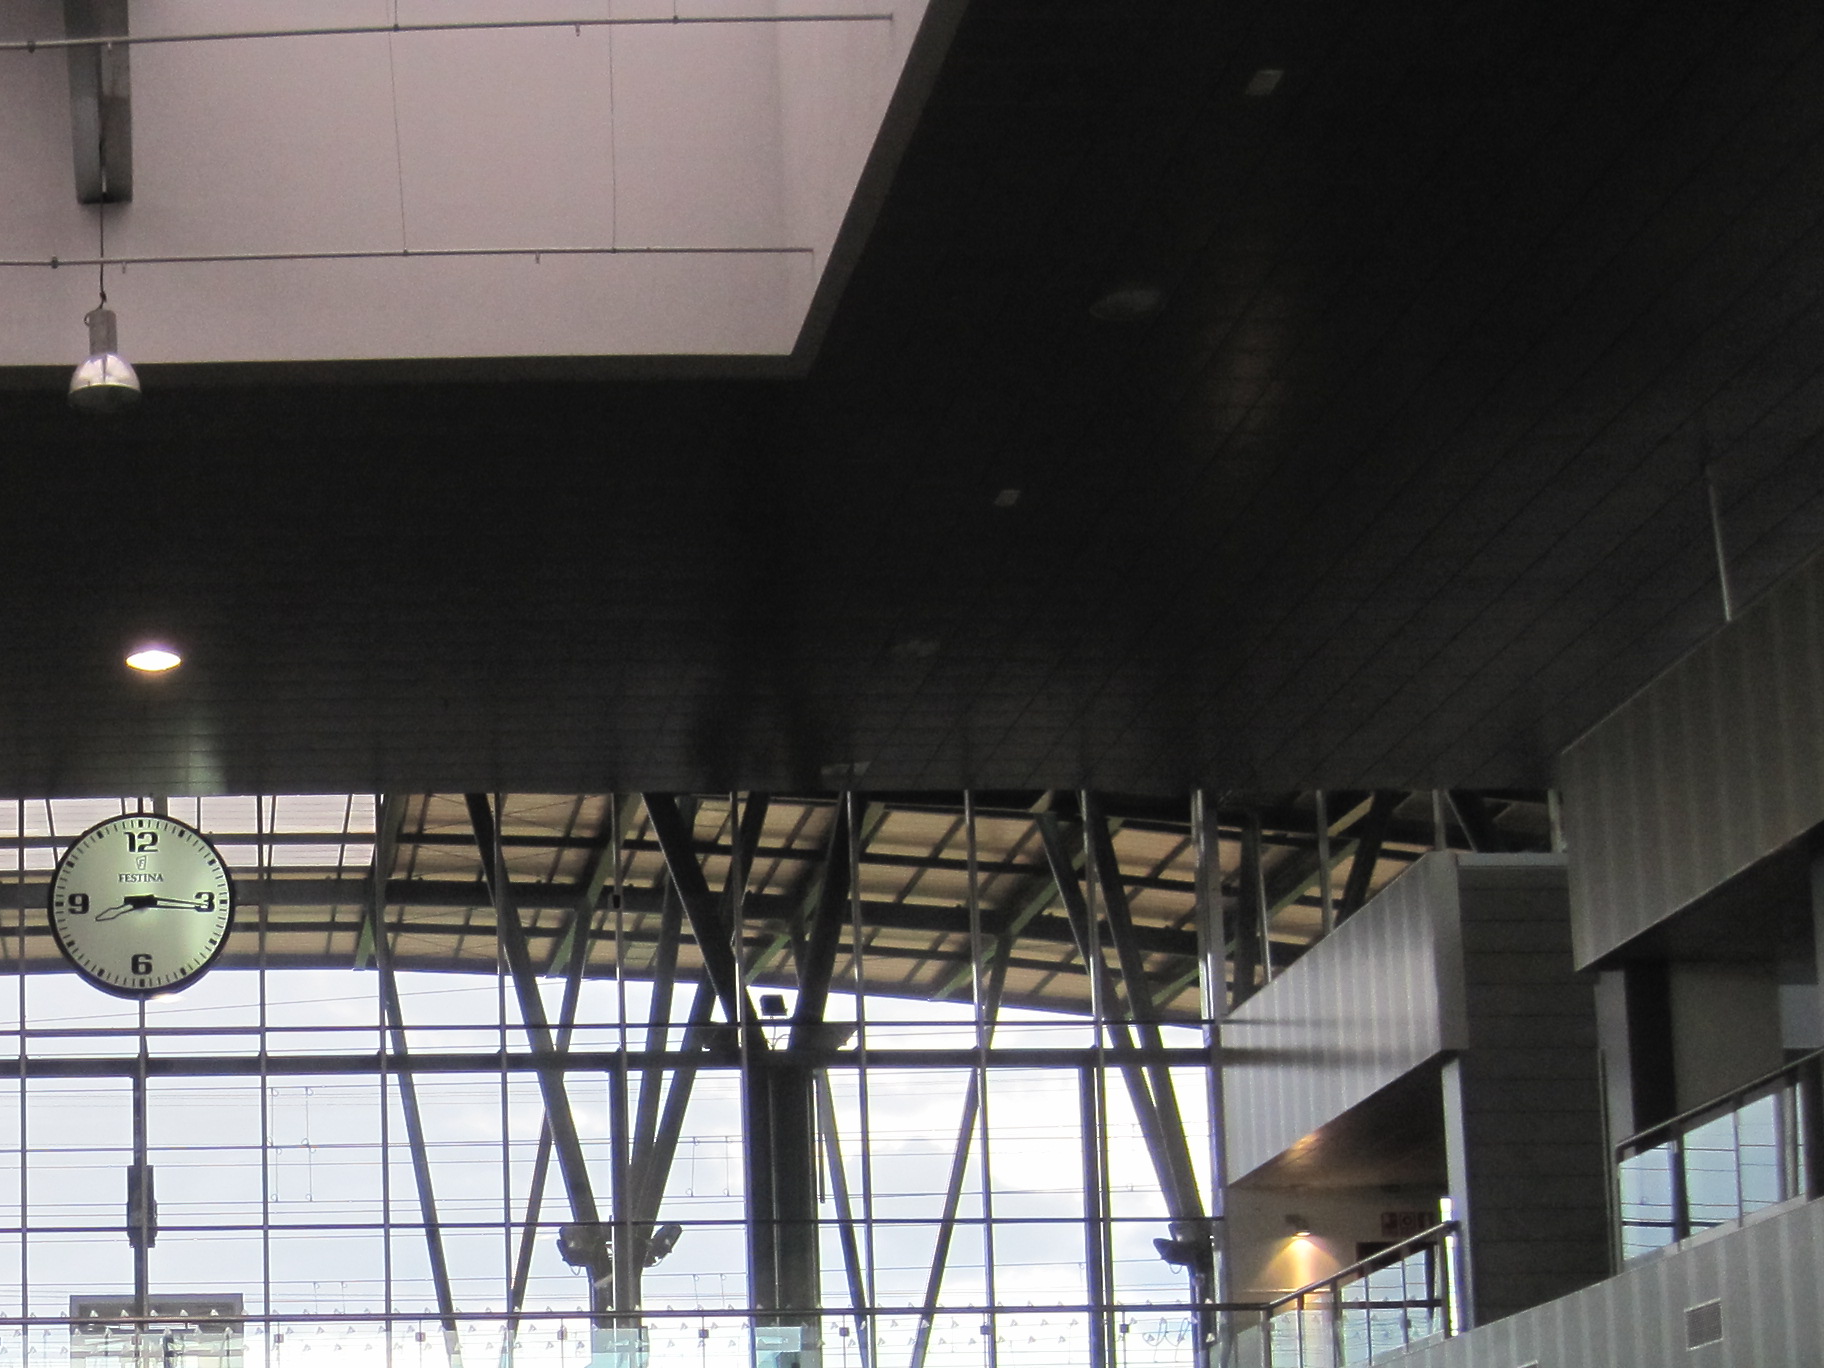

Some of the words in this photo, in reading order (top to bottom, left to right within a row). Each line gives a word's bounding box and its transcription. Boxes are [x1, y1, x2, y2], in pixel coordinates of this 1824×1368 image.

[124, 831, 159, 853] 12
[118, 873, 164, 883] FESTINA
[68, 893, 89, 915] 9
[194, 892, 215, 913] 3
[131, 953, 153, 975] 6
